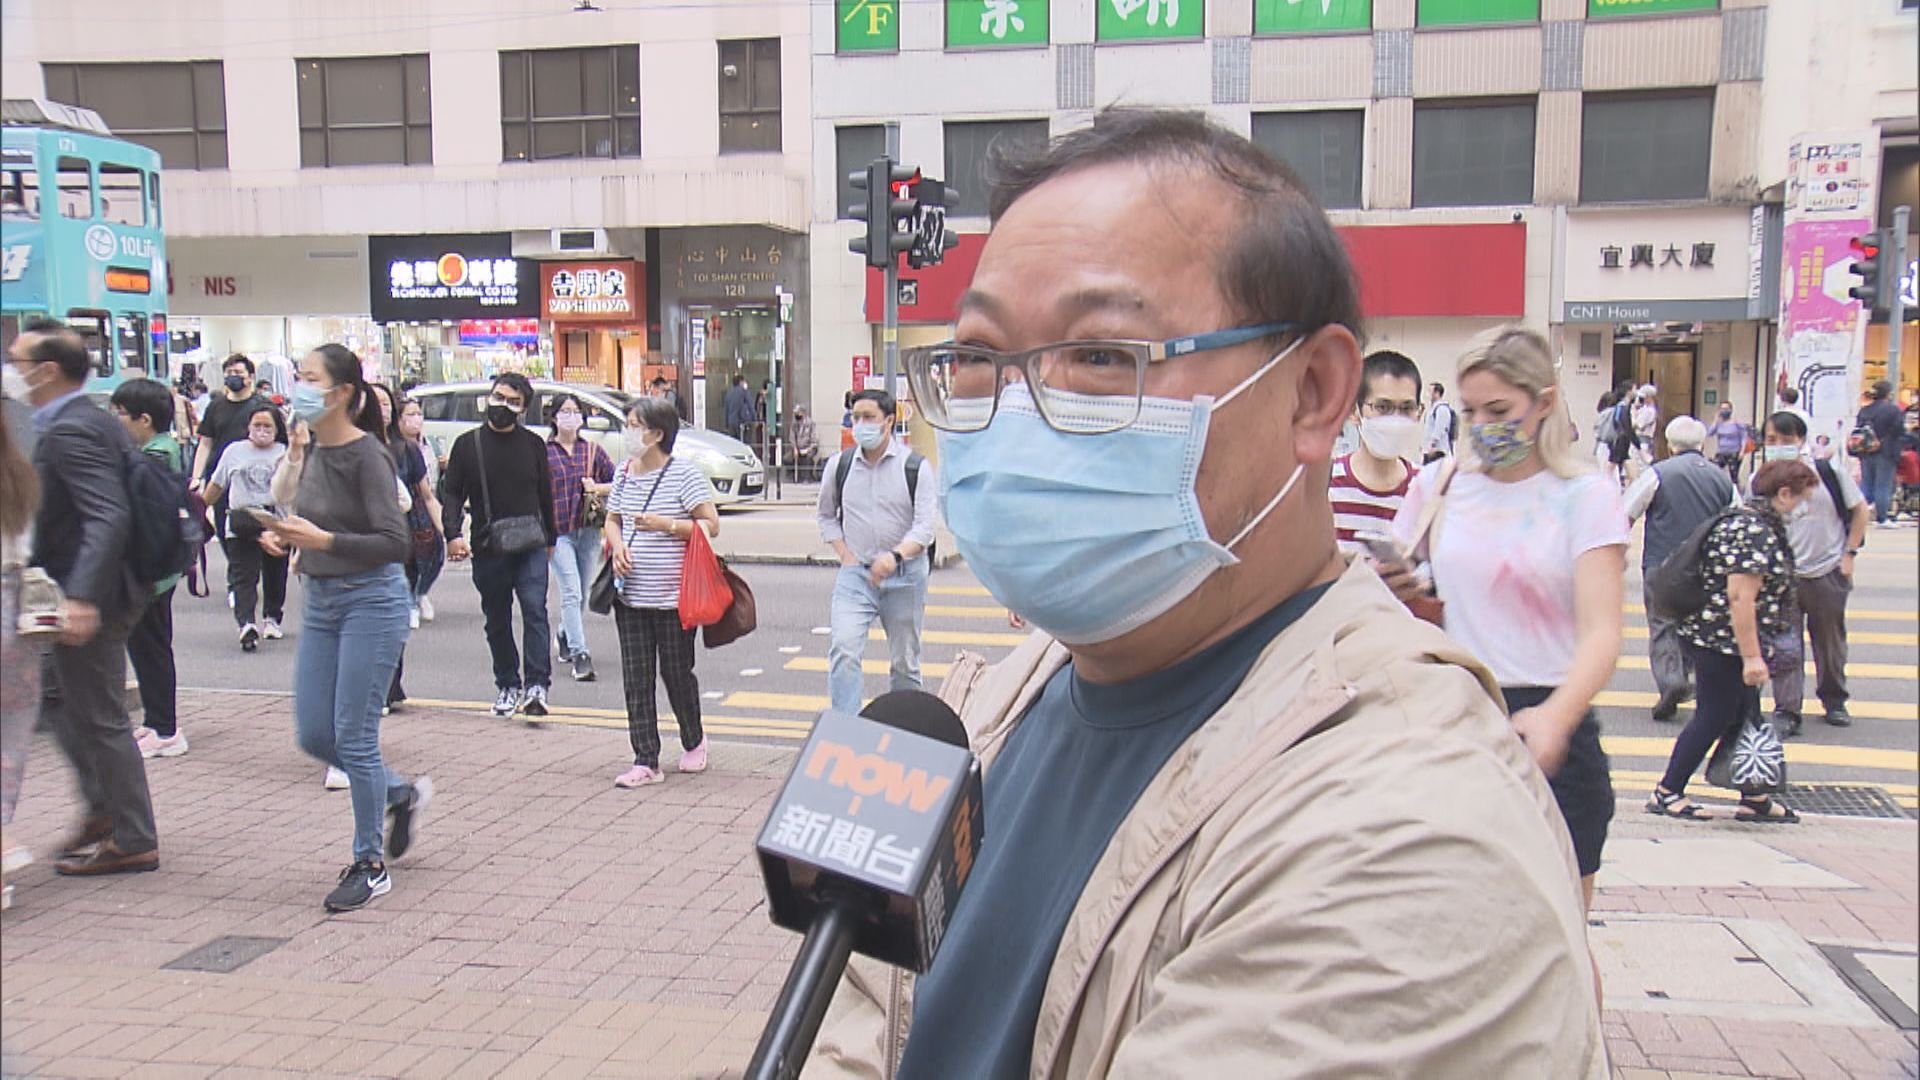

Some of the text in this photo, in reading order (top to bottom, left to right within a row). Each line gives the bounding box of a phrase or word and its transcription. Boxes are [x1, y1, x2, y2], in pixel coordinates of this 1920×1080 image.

[548, 299, 630, 314] YOSHINOYA
[1570, 305, 1650, 319] CNT House
[804, 738, 952, 815] now
[771, 803, 921, 884] 新聞台
